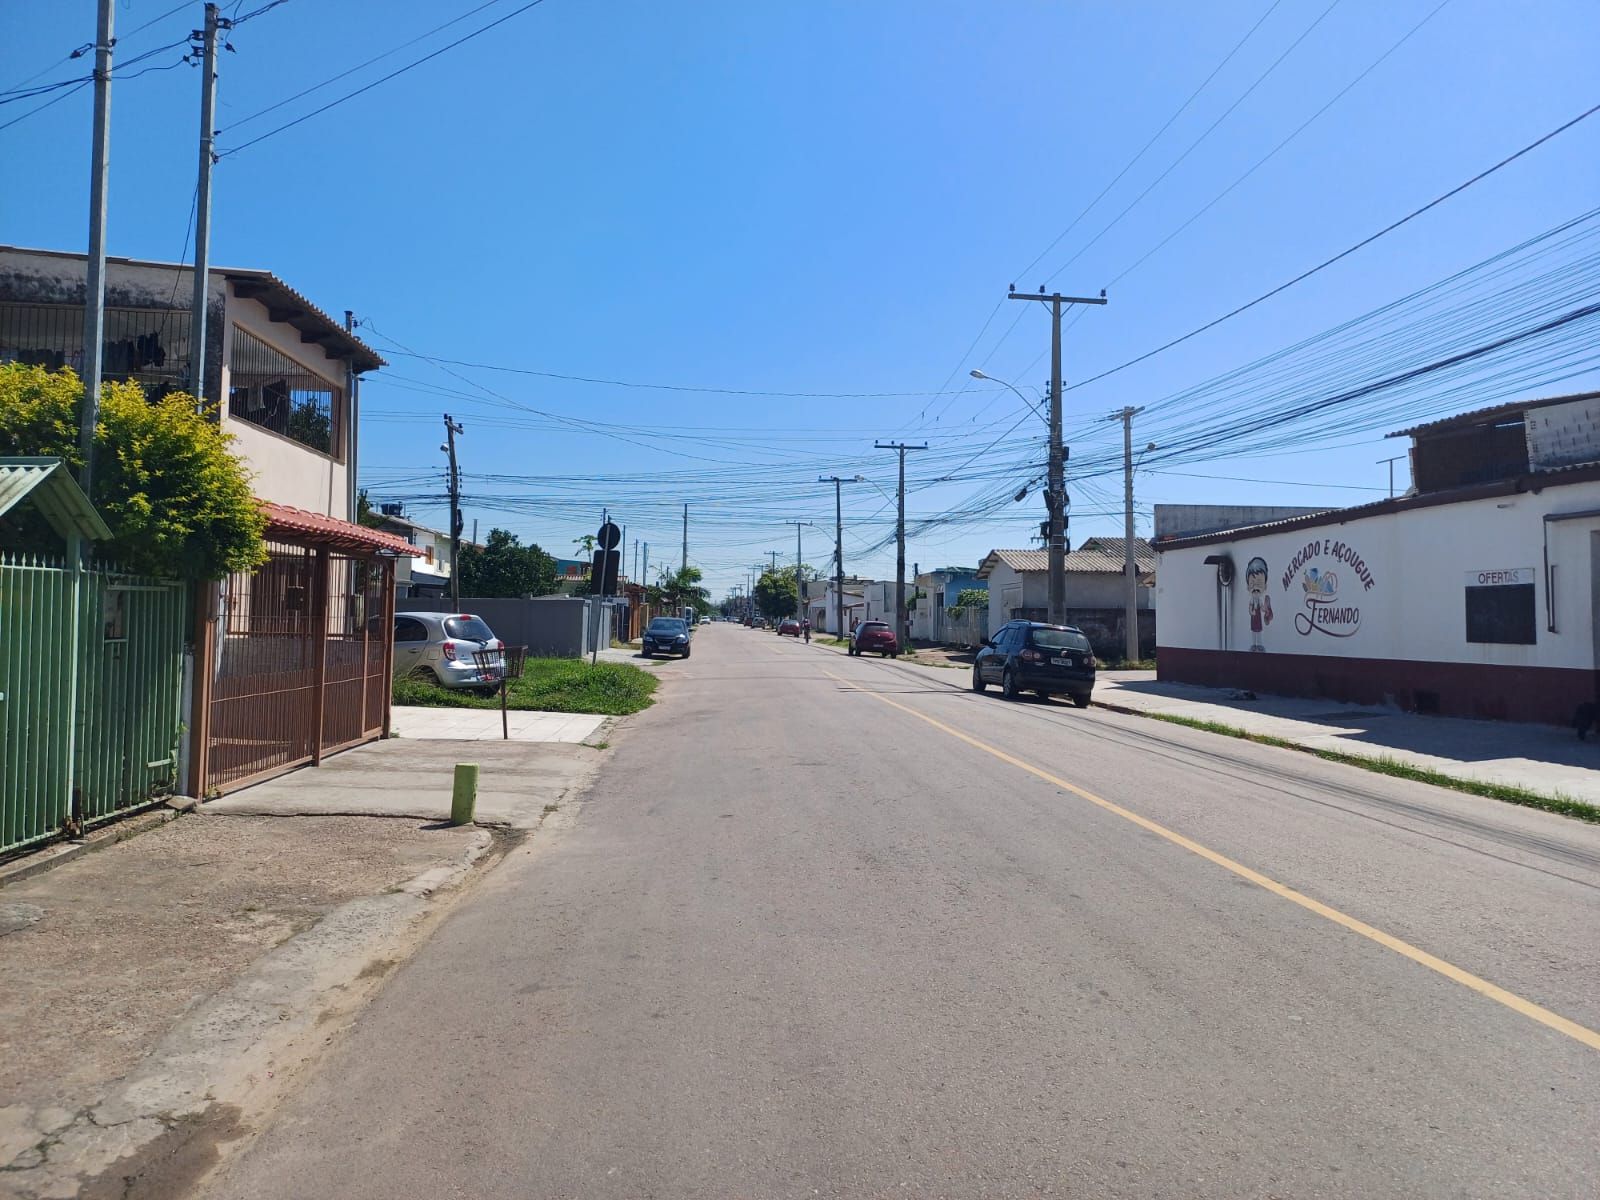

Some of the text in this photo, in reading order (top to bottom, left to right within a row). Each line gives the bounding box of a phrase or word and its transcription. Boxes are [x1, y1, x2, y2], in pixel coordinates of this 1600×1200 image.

[1282, 540, 1375, 592] MERCADO E AÇOUGUE
[1478, 570, 1519, 584] OFERTAS
